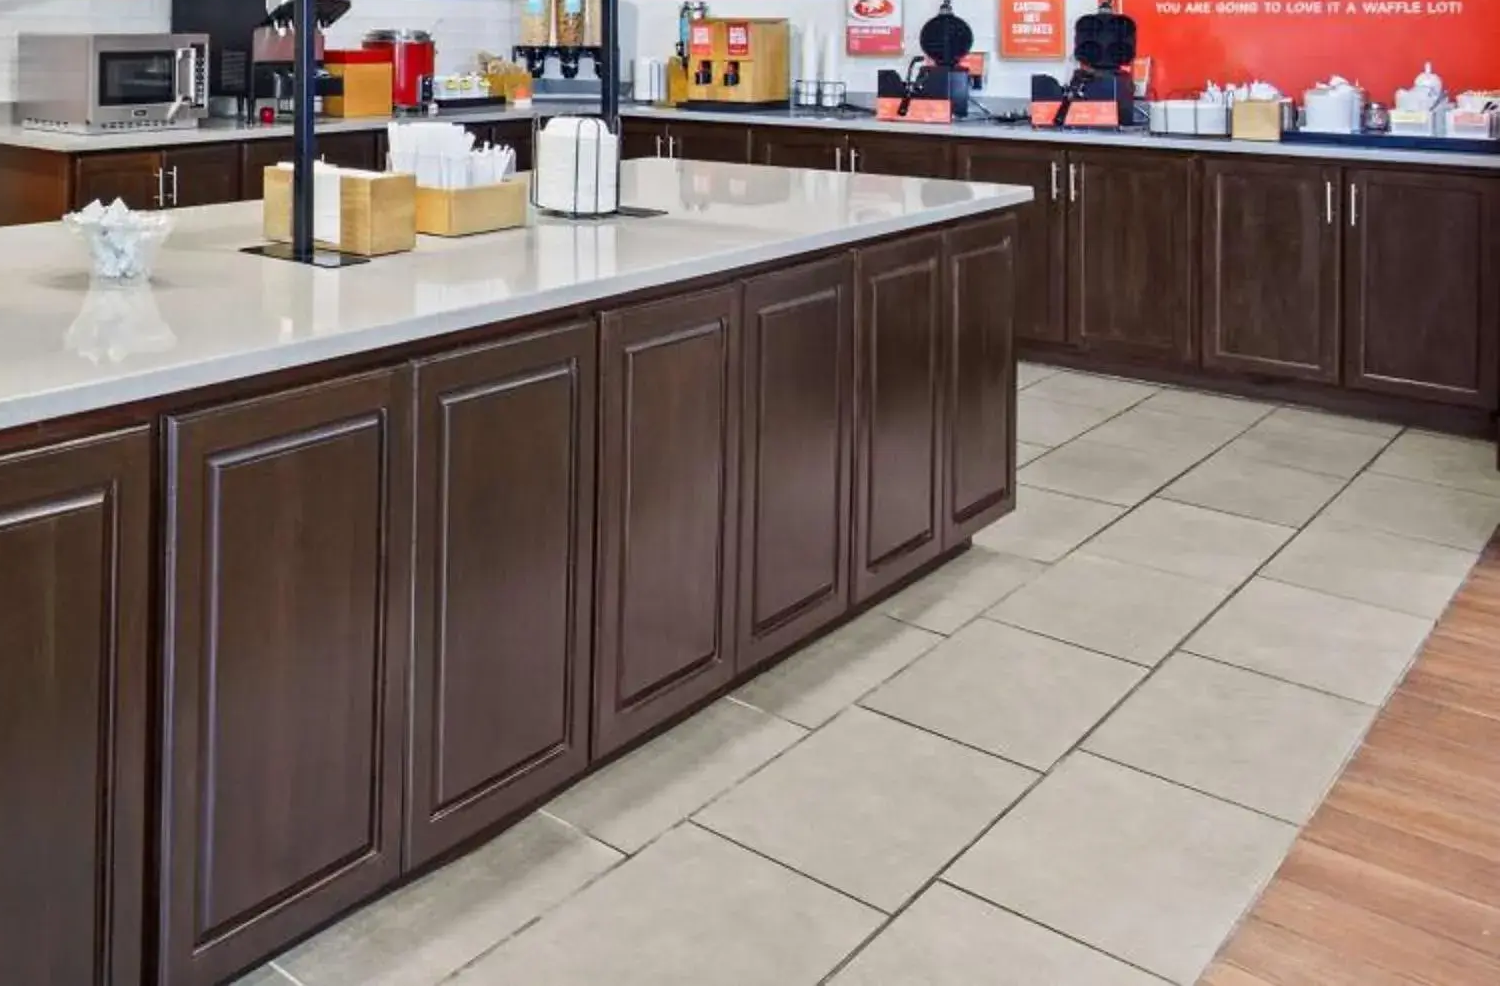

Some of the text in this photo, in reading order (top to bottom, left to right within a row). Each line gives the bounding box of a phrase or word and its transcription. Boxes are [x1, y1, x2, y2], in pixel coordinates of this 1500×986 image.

[1155, 2, 1181, 14] YOU
[1185, 2, 1211, 14] ARE
[1215, 2, 1257, 14] GOING
[1264, 2, 1282, 14] TO
[1287, 1, 1321, 14] LOVE
[1327, 1, 1341, 14] IT
[1347, 1, 1356, 13] A
[1363, 1, 1421, 13] WAFFLE
